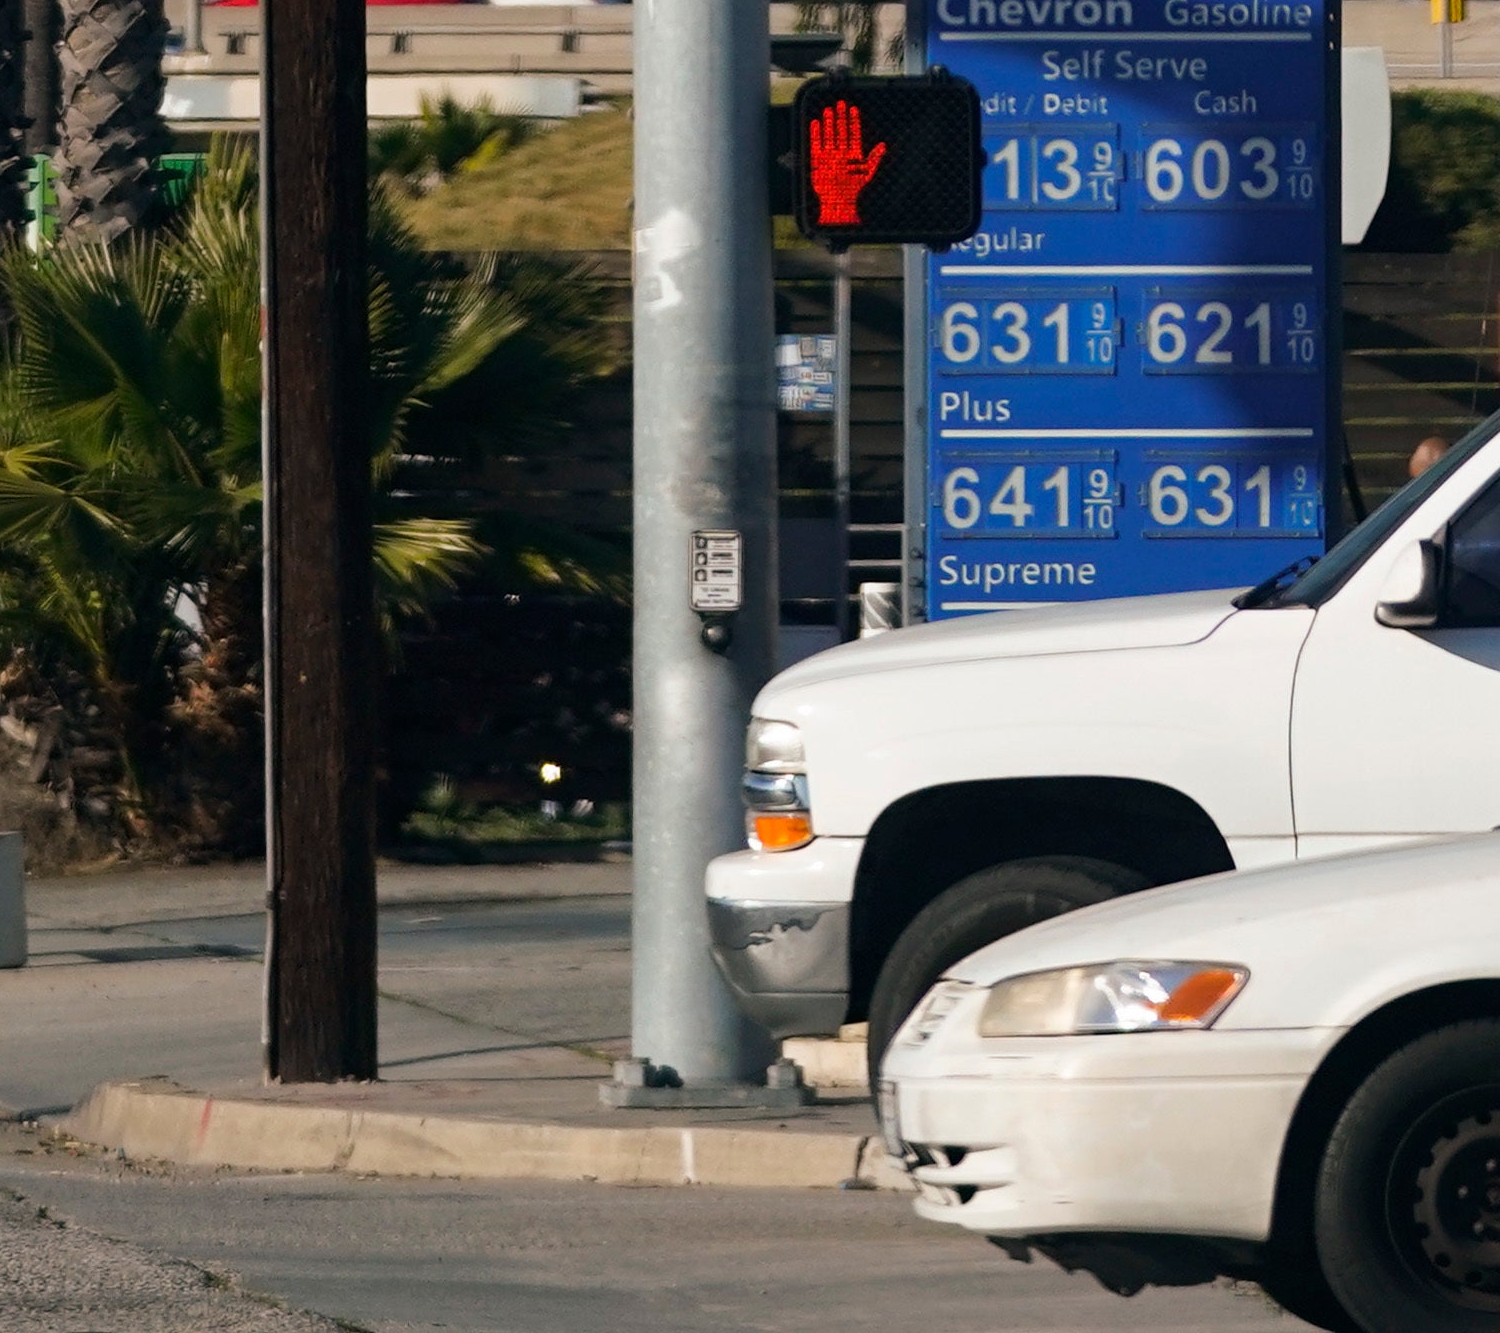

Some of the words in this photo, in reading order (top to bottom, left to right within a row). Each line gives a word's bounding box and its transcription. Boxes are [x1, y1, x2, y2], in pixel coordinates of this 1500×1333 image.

[1041, 50, 1106, 81] Self
[1114, 50, 1209, 80] Serve
[981, 93, 1017, 114] dit
[1042, 93, 1109, 115] Debit
[1194, 90, 1258, 115] Cash
[993, 138, 1083, 201] 13
[1145, 137, 1280, 202] 603
[950, 226, 1046, 257] egular
[941, 301, 1070, 364] 631
[1146, 301, 1272, 365] 621
[940, 391, 1011, 421] Plus
[942, 466, 1070, 529] 641
[1148, 465, 1272, 528] 631
[939, 555, 1097, 593] Supreme
